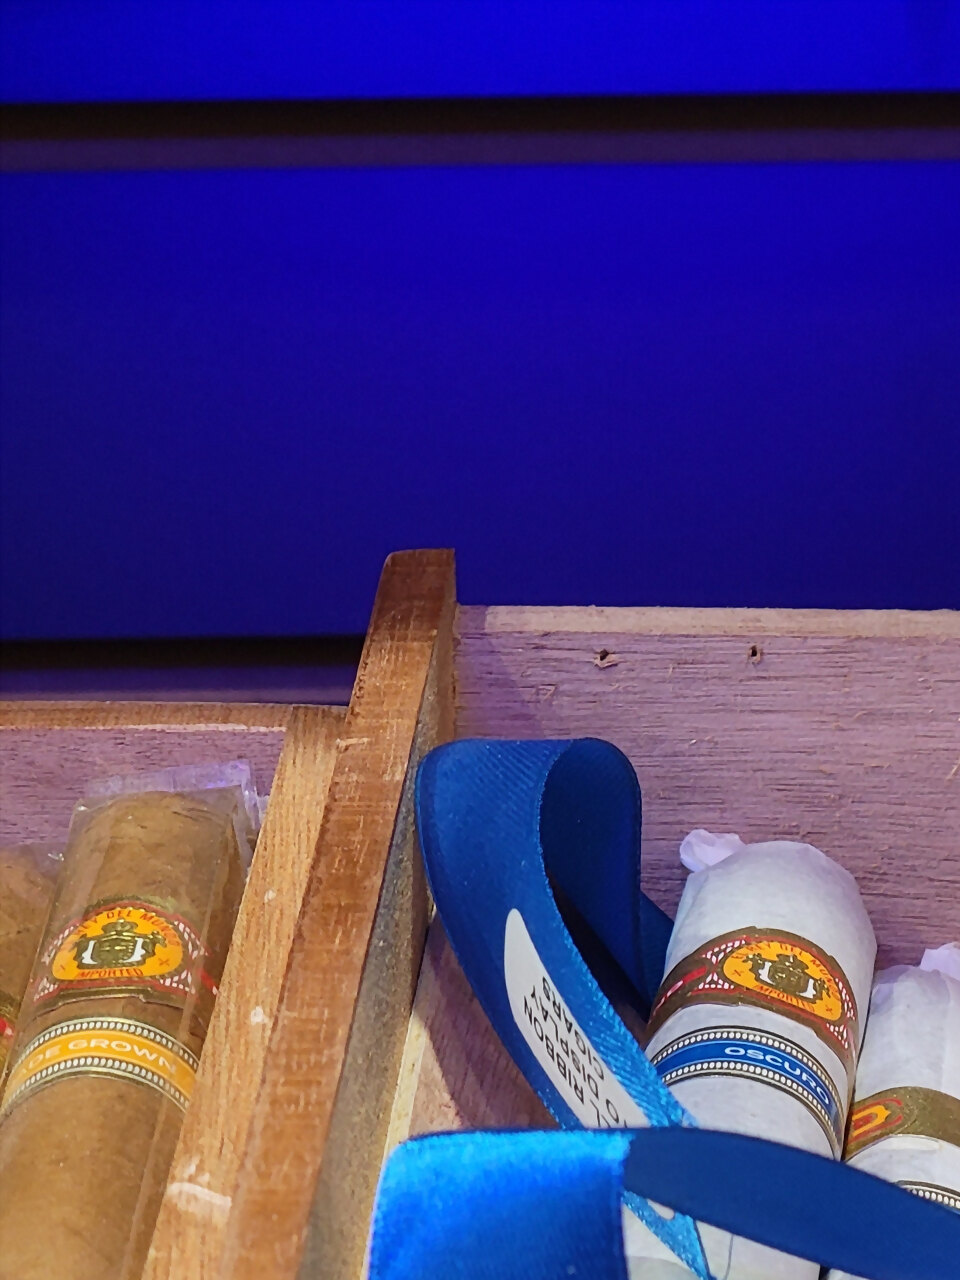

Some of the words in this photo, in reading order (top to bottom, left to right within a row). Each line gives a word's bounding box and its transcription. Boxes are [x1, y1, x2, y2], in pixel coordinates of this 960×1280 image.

[67, 1038, 177, 1073] GROWN
[523, 995, 584, 1105] RIBBON
[530, 984, 599, 1100] DISPLAY
[542, 976, 605, 1081] CIGARS
[724, 1046, 830, 1106] OSCURO
